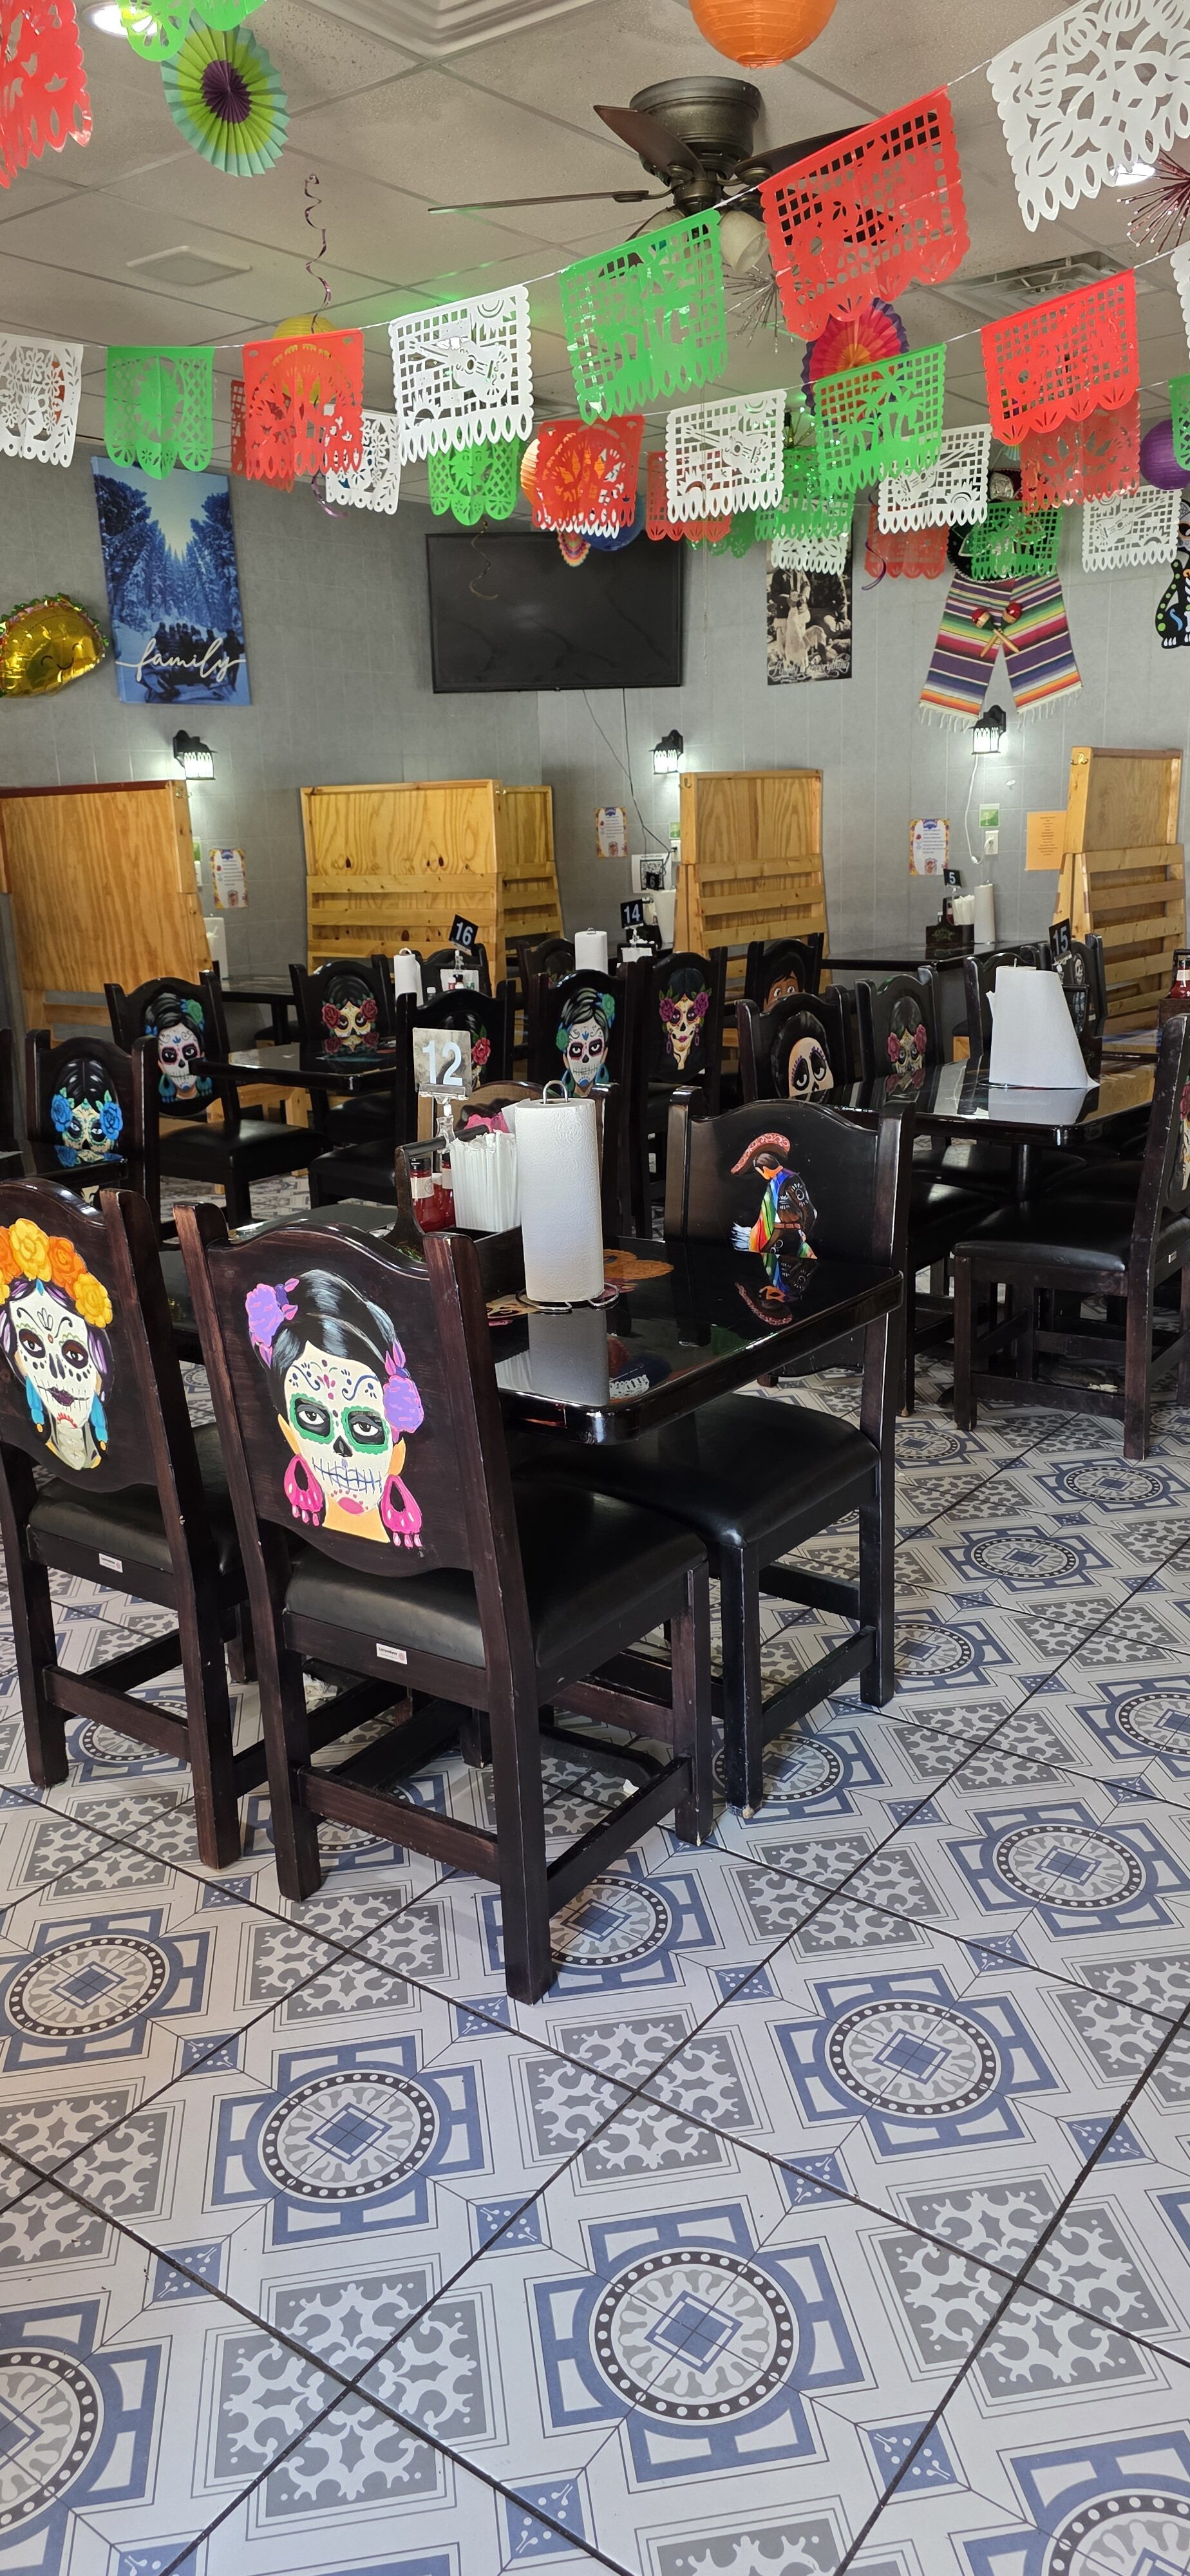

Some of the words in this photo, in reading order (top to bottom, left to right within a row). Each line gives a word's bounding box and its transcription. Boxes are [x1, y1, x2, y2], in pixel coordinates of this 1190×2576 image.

[115, 638, 247, 683] family
[650, 875, 656, 887] 6
[949, 871, 956, 885] 5
[624, 904, 640, 923] 14
[456, 922, 473, 945] 16
[1053, 925, 1068, 955] 15
[422, 1040, 463, 1086] 12
